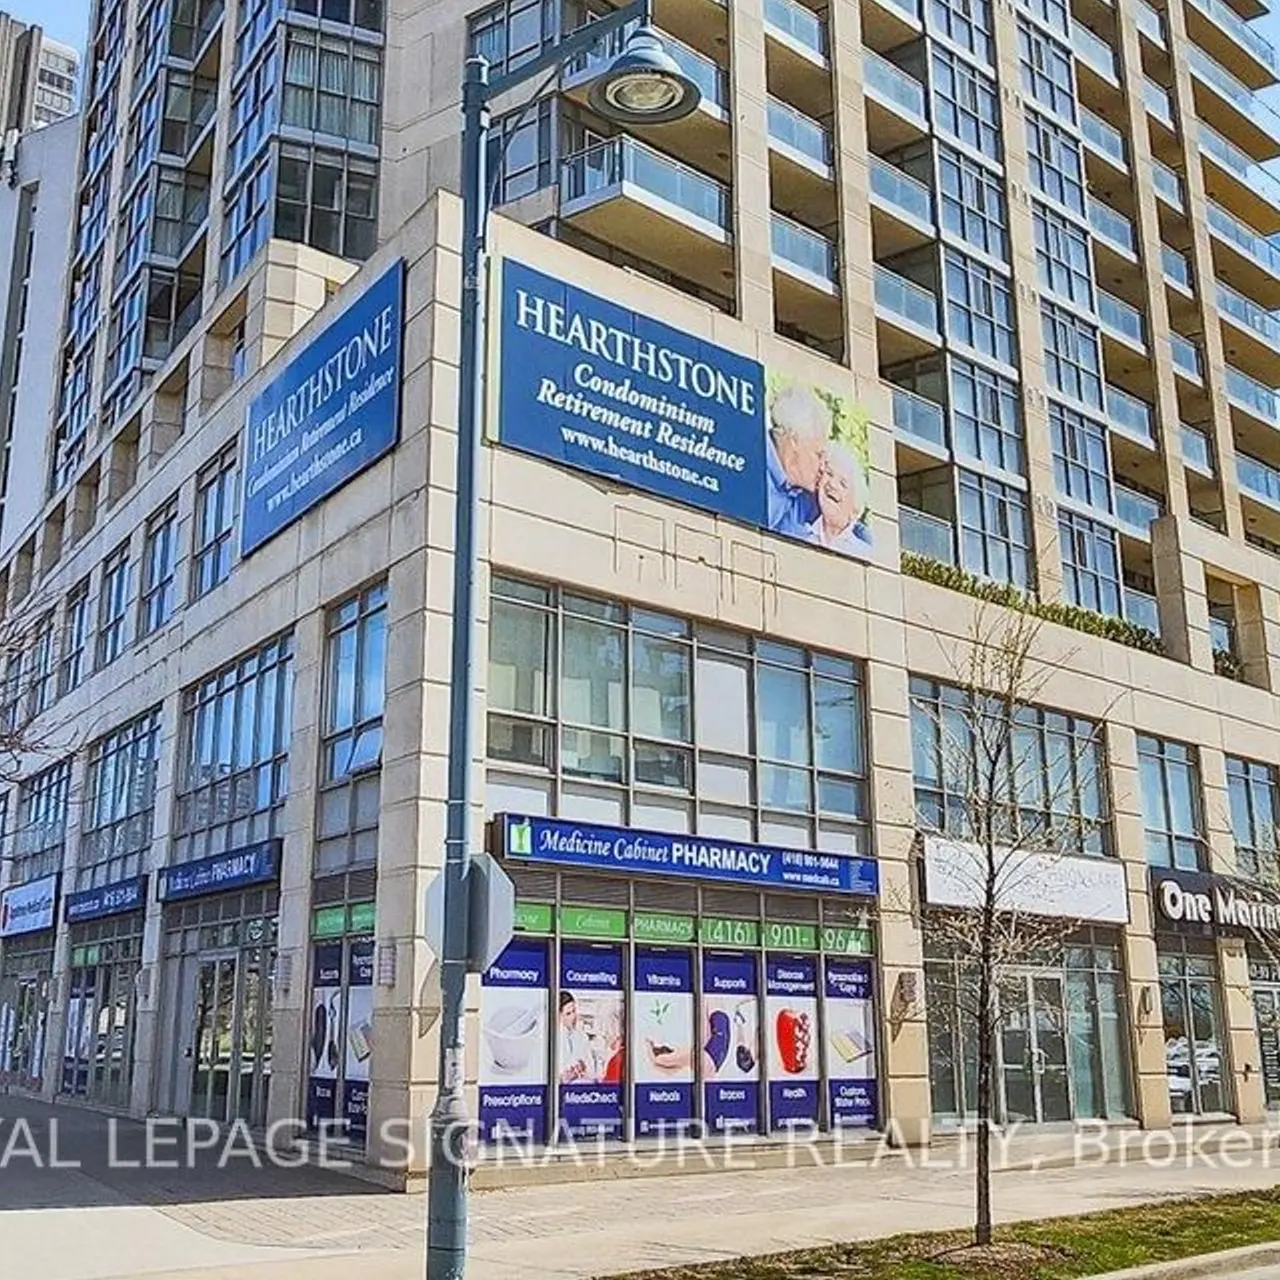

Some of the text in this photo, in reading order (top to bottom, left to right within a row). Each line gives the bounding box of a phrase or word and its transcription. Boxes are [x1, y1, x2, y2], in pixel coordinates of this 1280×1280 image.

[516, 289, 755, 416] HEARTHSTONE
[253, 305, 393, 463] HEARTHSTONE
[574, 363, 716, 434] Condominium
[536, 378, 746, 472] Retirement Residence
[561, 426, 720, 492] www.hearthstone.ca
[539, 829, 772, 875] Medicine Cabinet PHARMACY
[1161, 880, 1212, 923] One
[634, 917, 693, 937] PHARMACY
[707, 920, 751, 945] (416)
[771, 924, 810, 948] 901-
[489, 966, 540, 983] Pharmacy
[483, 1092, 542, 1108] Prescriptions
[565, 1091, 618, 1105] MedsCheck
